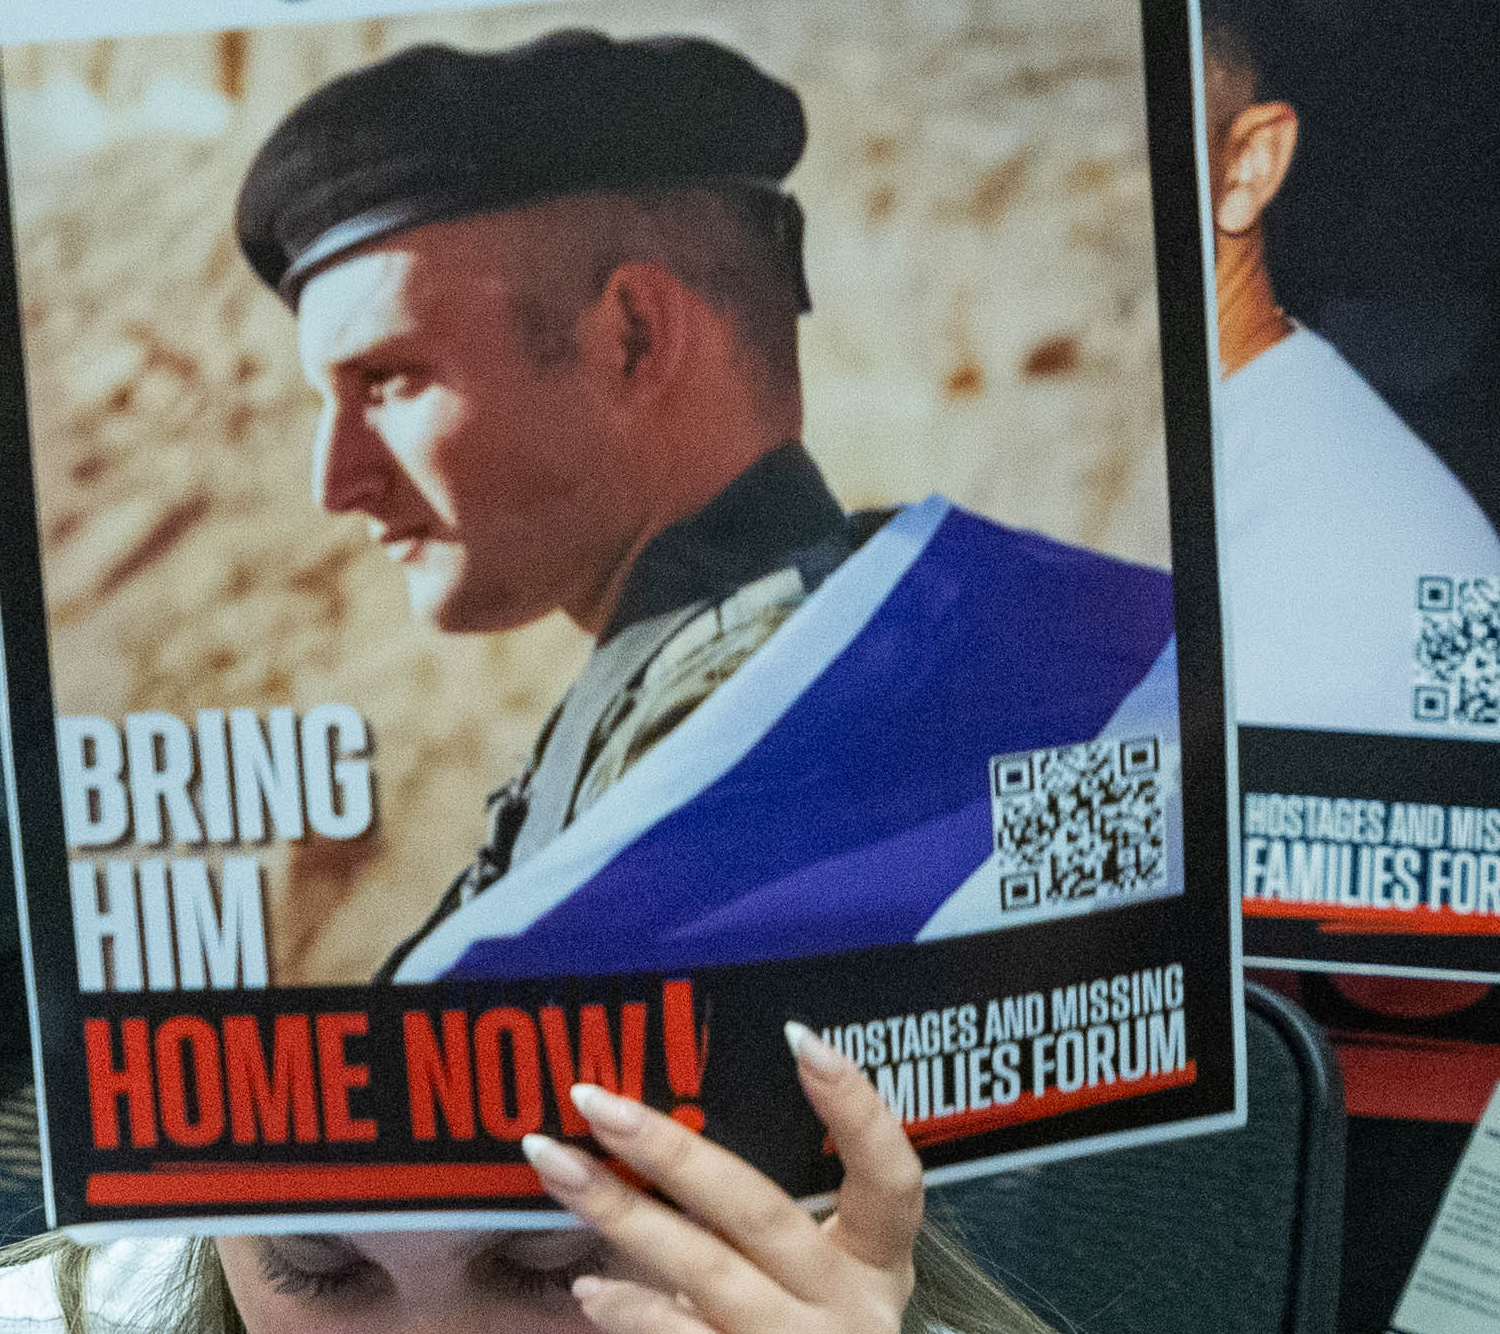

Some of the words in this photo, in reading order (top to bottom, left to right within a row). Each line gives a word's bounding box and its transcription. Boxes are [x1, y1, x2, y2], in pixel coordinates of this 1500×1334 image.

[56, 702, 375, 847] BRING
[1389, 801, 1445, 848] AND
[69, 854, 268, 993] HIM
[1244, 837, 1421, 909] FAMILIES
[1428, 849, 1500, 914] FOR
[983, 991, 1046, 1043] AND
[1051, 962, 1184, 1033] MISSING
[82, 1010, 379, 1149] HOME
[861, 1043, 1021, 1123] MILIES
[1033, 1008, 1187, 1098] FORUM
